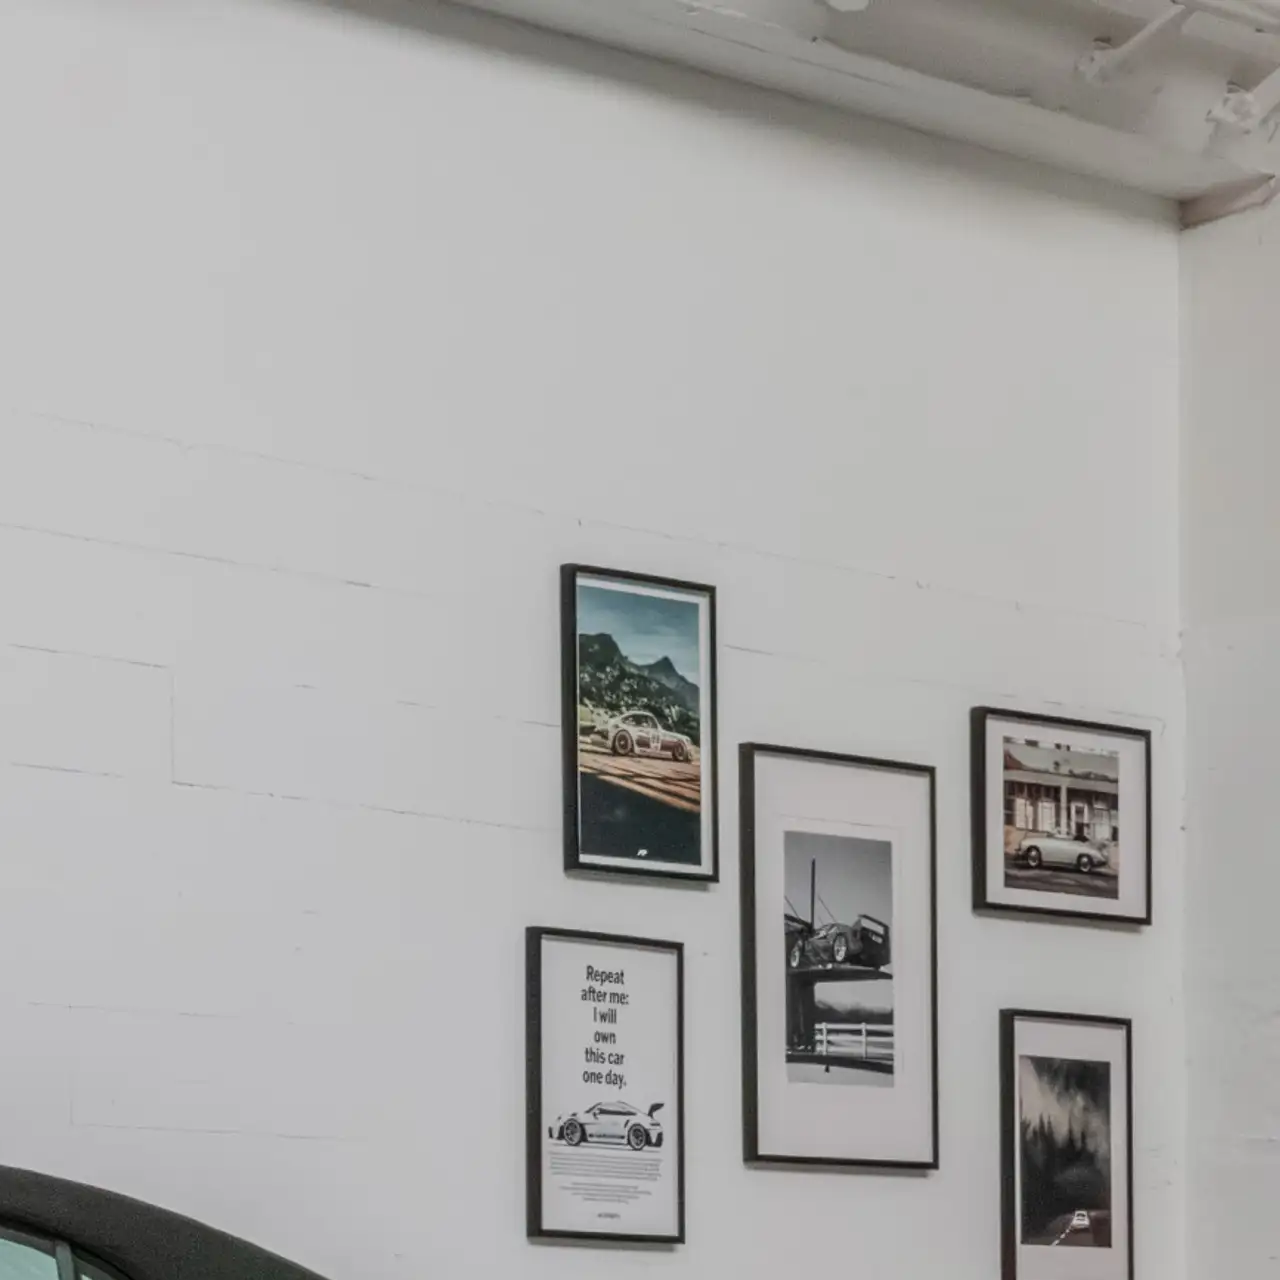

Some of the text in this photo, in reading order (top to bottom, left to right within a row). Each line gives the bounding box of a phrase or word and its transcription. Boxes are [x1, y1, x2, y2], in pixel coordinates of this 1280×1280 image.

[586, 965, 624, 986] Repeat
[581, 986, 629, 1005] after me:
[593, 1006, 617, 1024] I will
[594, 1031, 616, 1044] own
[585, 1047, 624, 1065] this car
[582, 1069, 627, 1090] one day.
